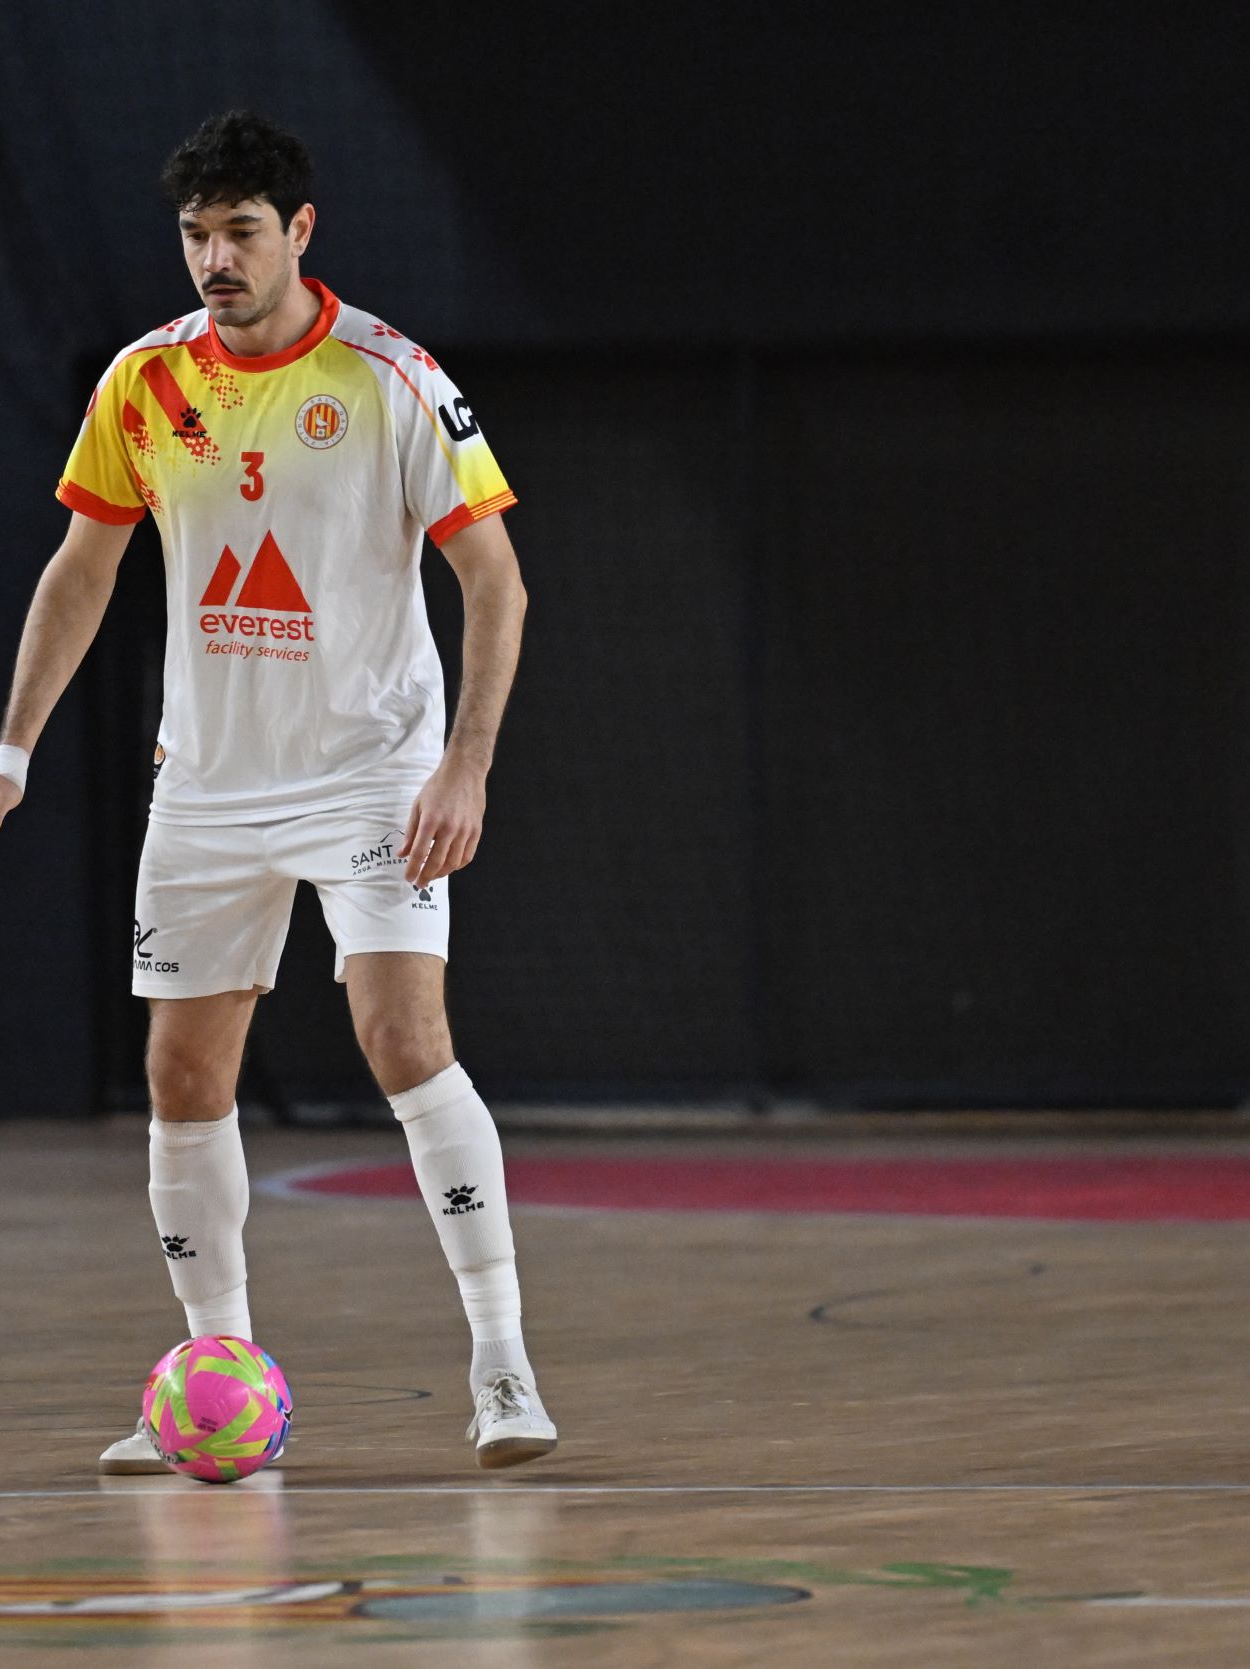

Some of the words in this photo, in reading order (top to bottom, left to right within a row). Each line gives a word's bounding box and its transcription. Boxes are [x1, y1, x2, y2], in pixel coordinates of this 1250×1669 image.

[240, 451, 265, 502] 3
[199, 613, 315, 642] everest
[206, 640, 254, 659] facility
[256, 646, 310, 662] services
[351, 844, 393, 869] SANT
[377, 858, 408, 867] MINERA
[411, 902, 439, 911] KELME
[154, 961, 180, 973] COS
[442, 1201, 485, 1216] KELME
